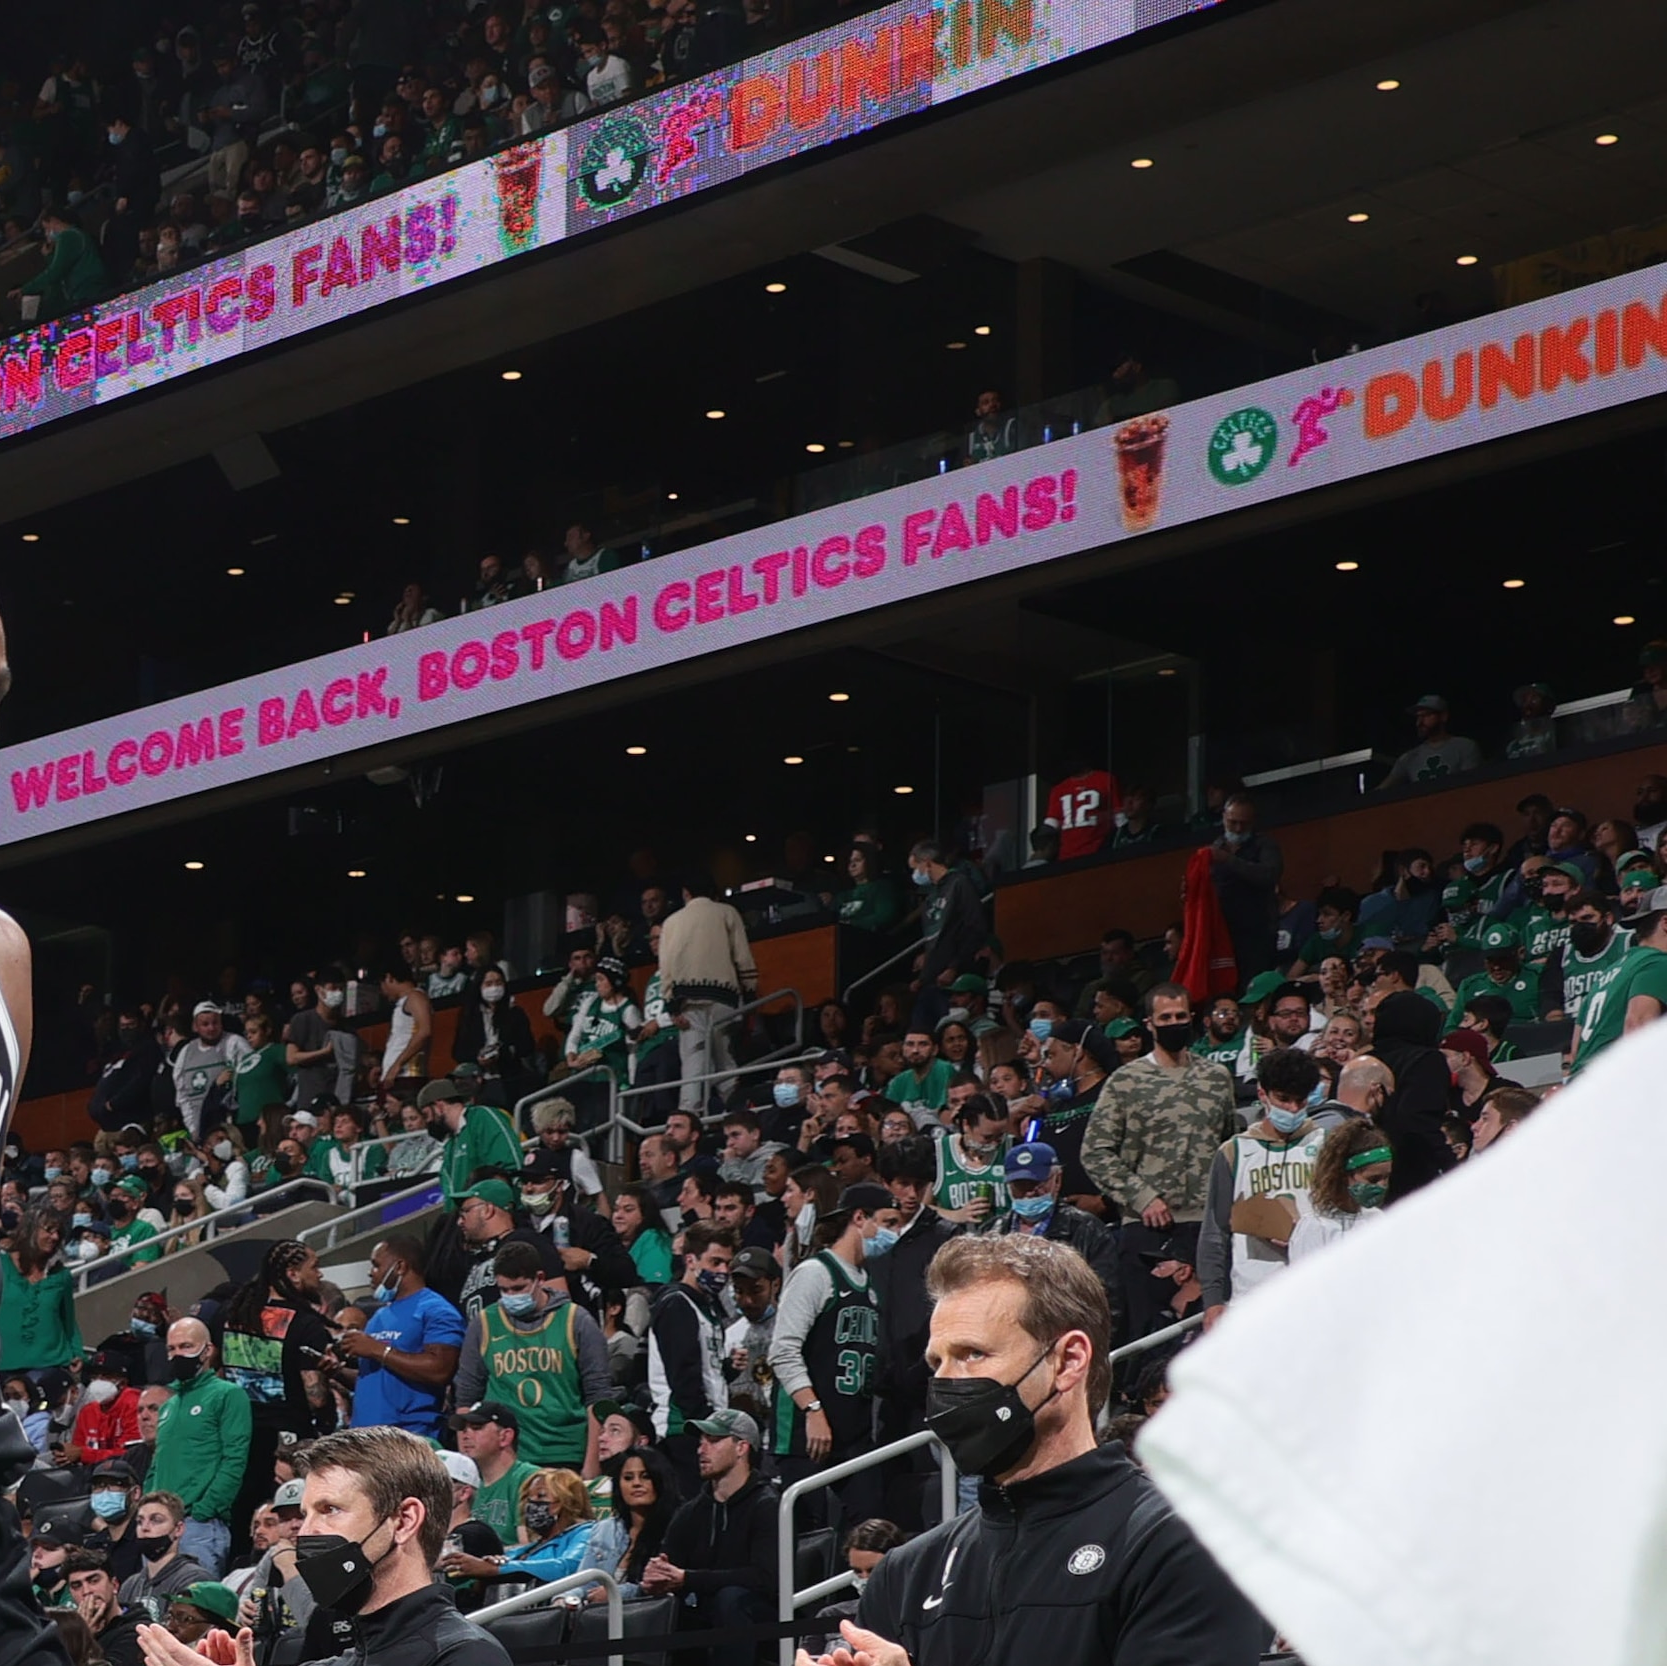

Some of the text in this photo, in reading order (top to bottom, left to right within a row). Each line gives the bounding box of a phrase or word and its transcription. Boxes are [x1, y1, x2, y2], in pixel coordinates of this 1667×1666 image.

[58, 264, 274, 390] CELTICS
[292, 193, 457, 307] FANS!
[1211, 412, 1273, 453] CELTICS
[11, 467, 1080, 814] WELCOME BACK, BOSTON CELTICS FANS!
[1059, 790, 1098, 831] 12
[947, 1180, 1005, 1210] BOSN
[1250, 1162, 1312, 1196] BOSTON
[493, 1347, 563, 1378] BOSTON
[517, 1378, 543, 1407] 0
